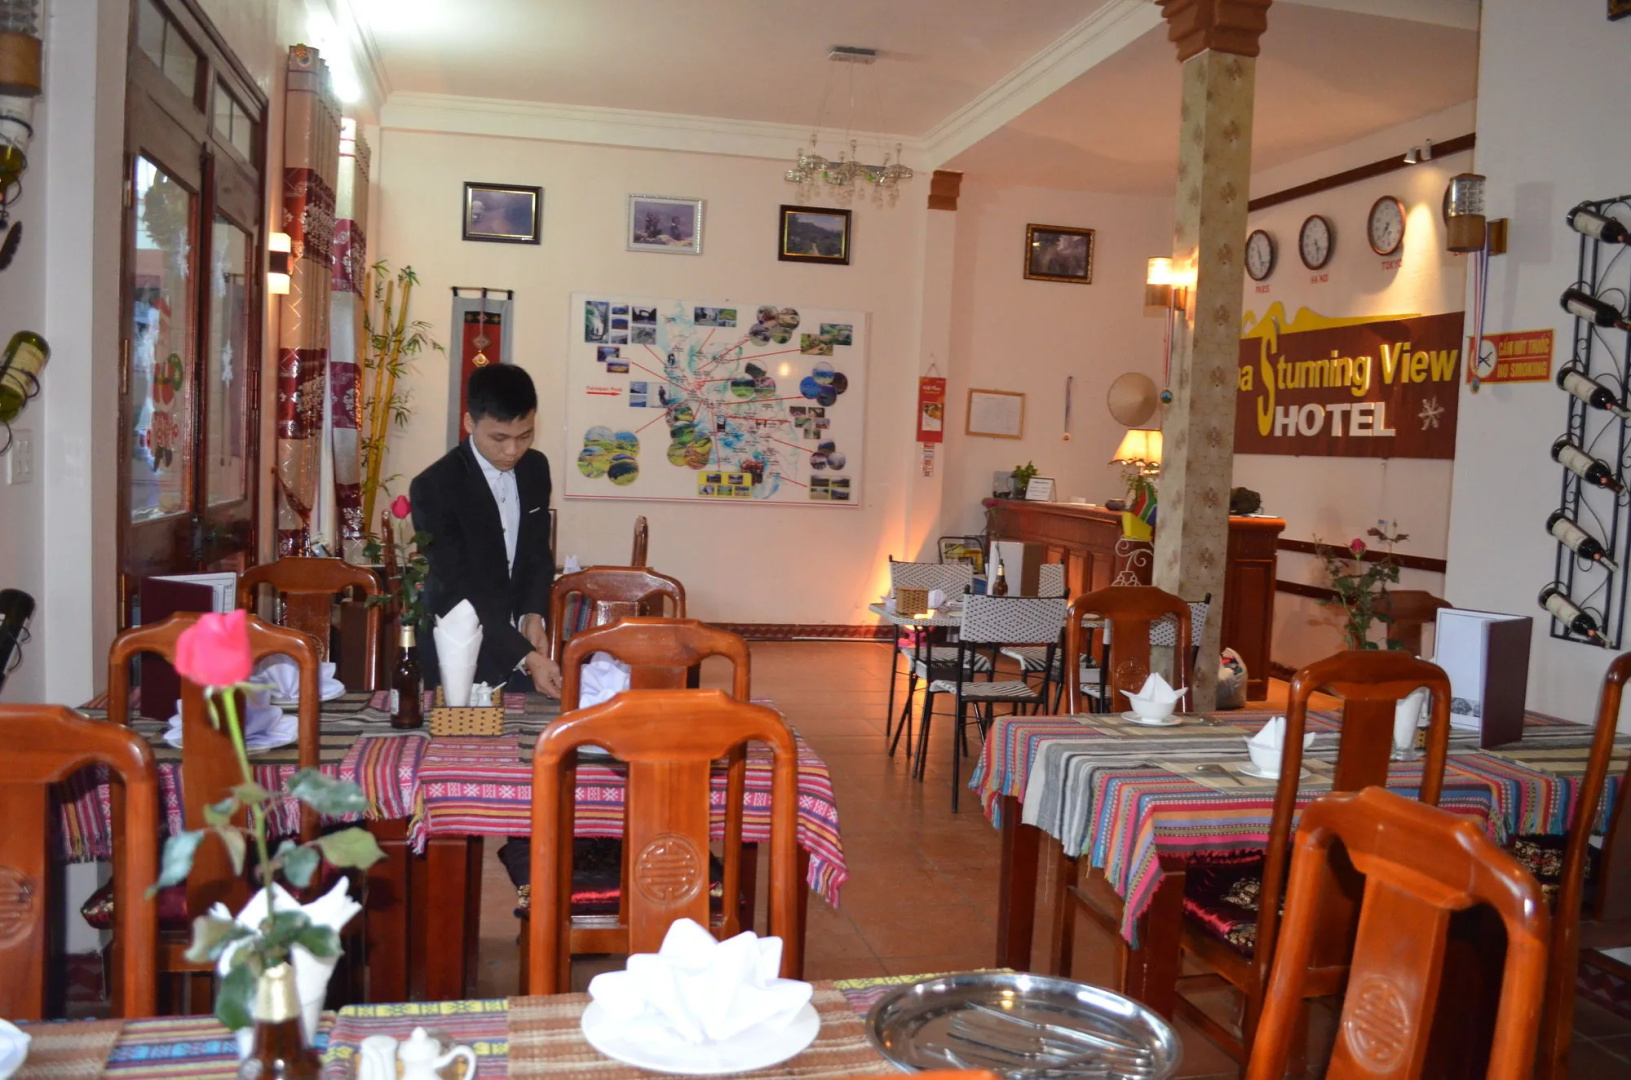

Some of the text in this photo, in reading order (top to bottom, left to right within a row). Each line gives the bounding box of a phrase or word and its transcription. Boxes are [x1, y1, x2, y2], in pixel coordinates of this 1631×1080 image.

[1257, 318, 1371, 437] Stunning
[1380, 341, 1458, 384] View
[1497, 361, 1547, 378] NO SMOKING
[1274, 401, 1396, 437] HOTEL
